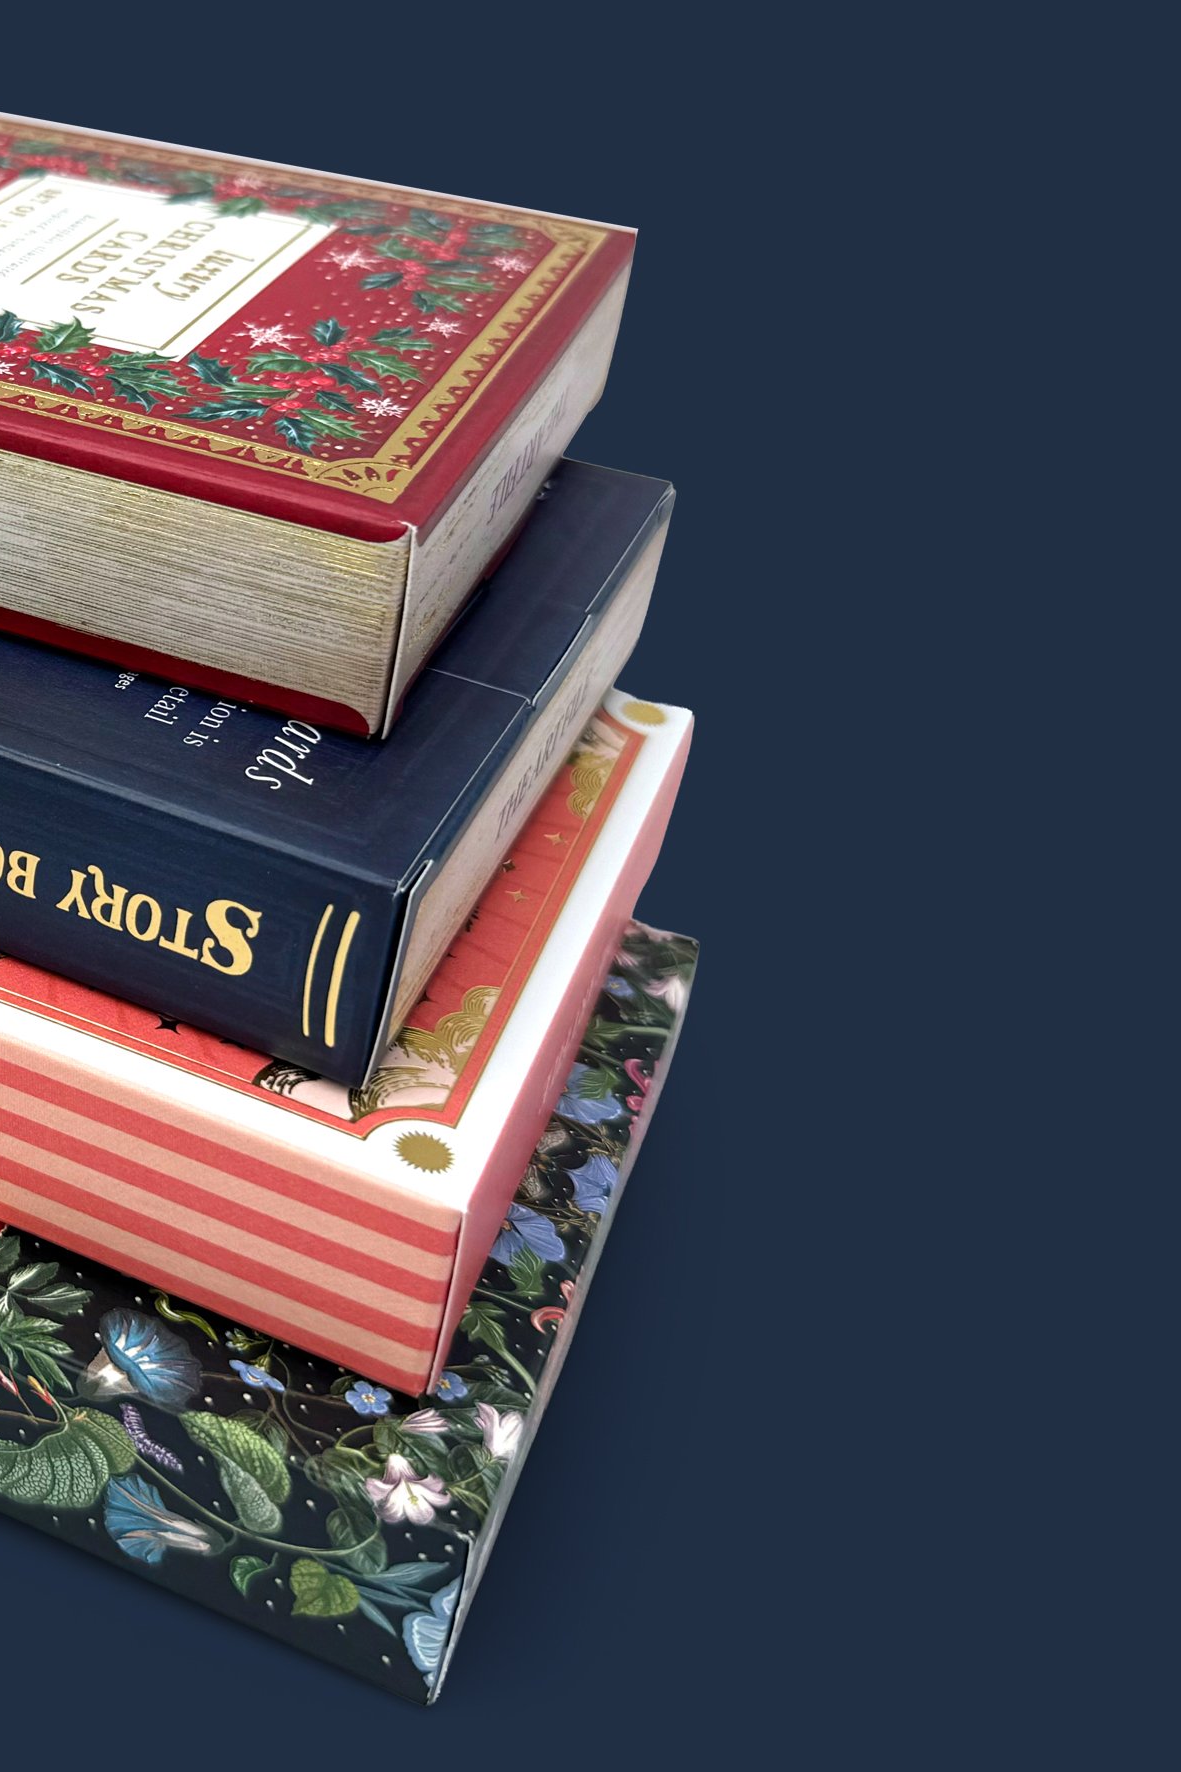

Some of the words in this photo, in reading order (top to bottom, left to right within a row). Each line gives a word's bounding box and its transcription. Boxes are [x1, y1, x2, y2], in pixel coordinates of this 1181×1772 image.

[55, 229, 148, 284] CARDS
[70, 220, 214, 314] CHRISTMAS
[153, 249, 254, 301] luxury
[182, 731, 219, 747] is
[55, 864, 262, 976] STORY
